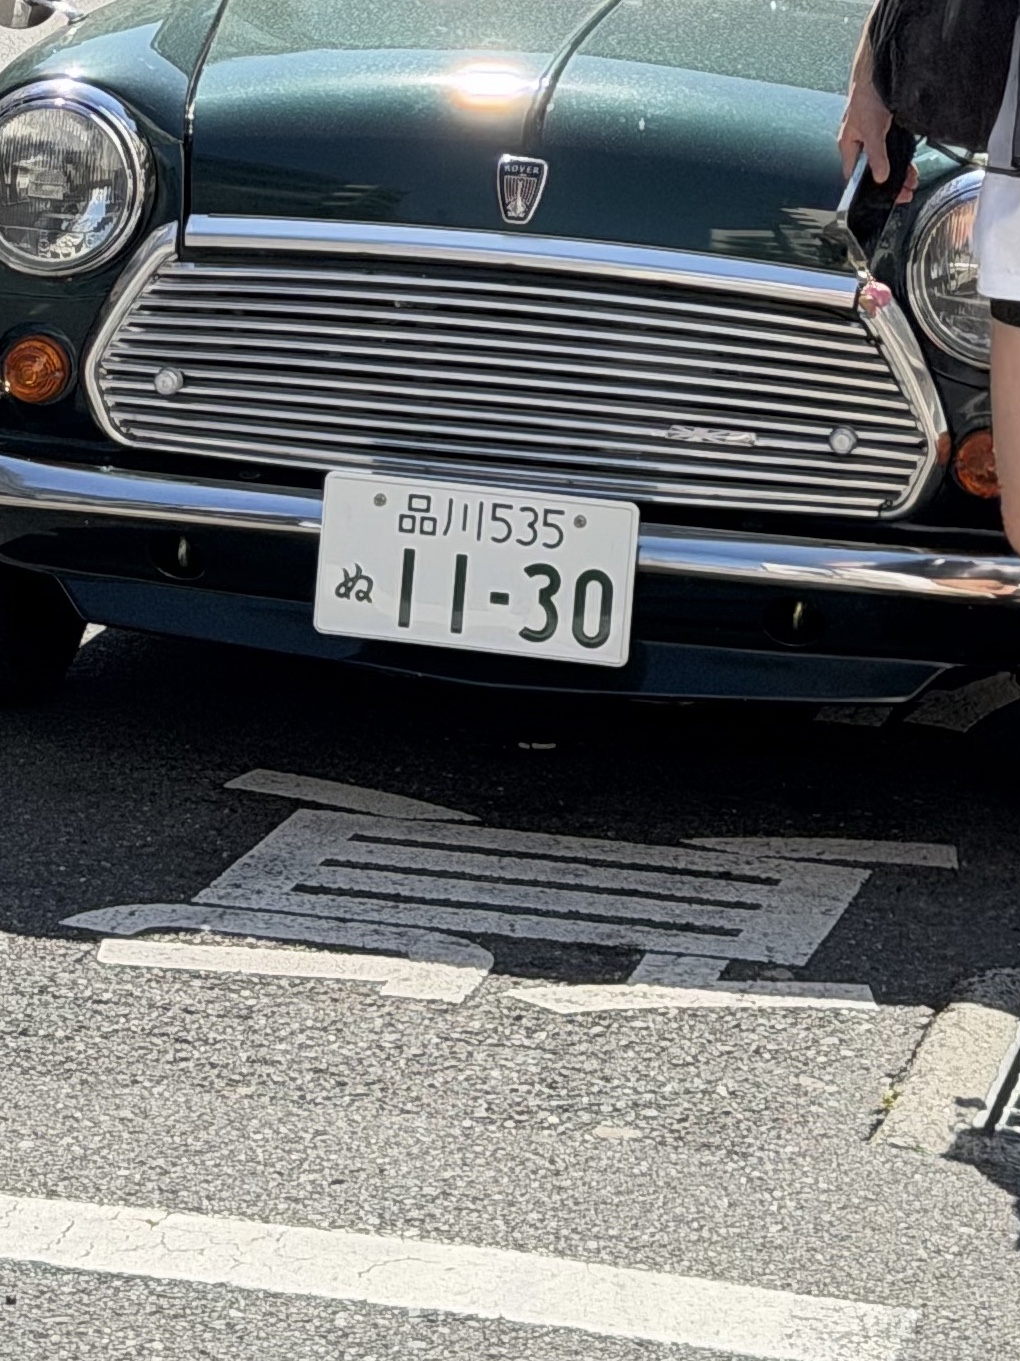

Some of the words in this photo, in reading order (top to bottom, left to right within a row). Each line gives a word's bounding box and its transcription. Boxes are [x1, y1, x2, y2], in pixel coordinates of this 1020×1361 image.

[504, 165, 539, 174] ROVER
[334, 562, 375, 604] ぬ
[397, 547, 614, 649] 11-30
